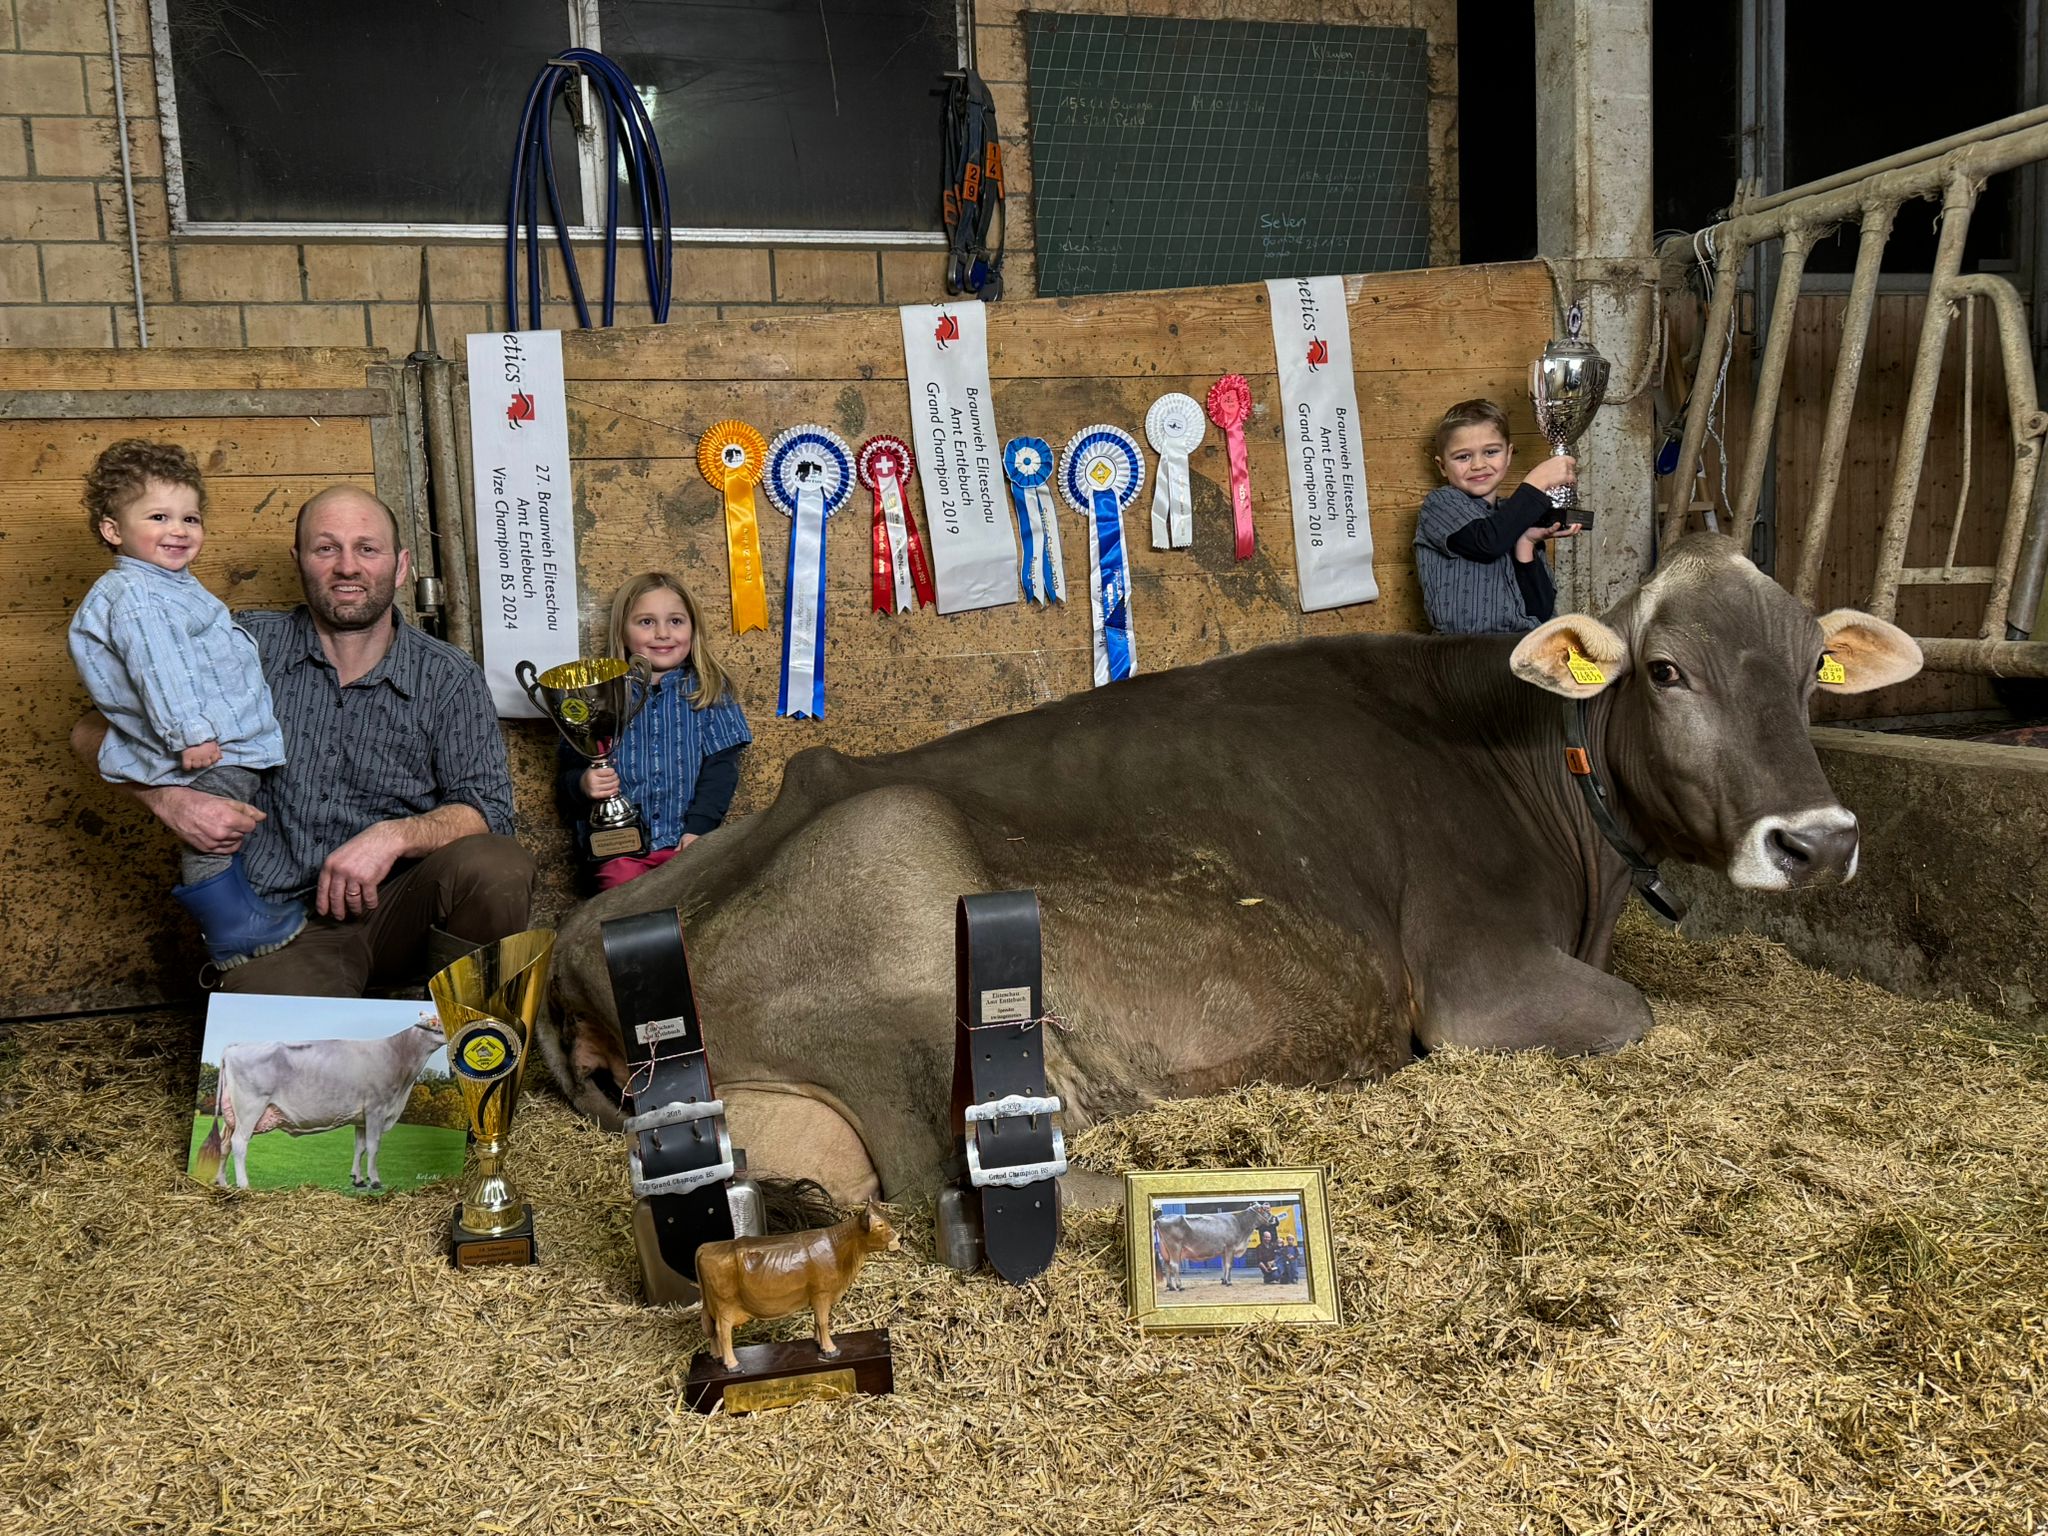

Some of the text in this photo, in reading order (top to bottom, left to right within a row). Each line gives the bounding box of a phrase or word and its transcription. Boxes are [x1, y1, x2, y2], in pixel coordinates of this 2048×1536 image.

[926, 381, 960, 535] Grand Champion 2019
[950, 407, 973, 507] Amt Entlebuch
[967, 387, 995, 524] Braunvieh Eliteschau
[1298, 402, 1323, 547] Grand Champion 2018
[1320, 426, 1338, 521] Amt Entlebuch
[1336, 407, 1358, 539] Braunvieh Eliteschau
[492, 466, 518, 630] Vize Champion BS 2024
[516, 497, 536, 599] Amt Entlebuch
[535, 464, 558, 631] 27. Braunvieh Eliteschau
[651, 1180, 671, 1190] Grand
[1008, 1169, 1039, 1180] Champion
